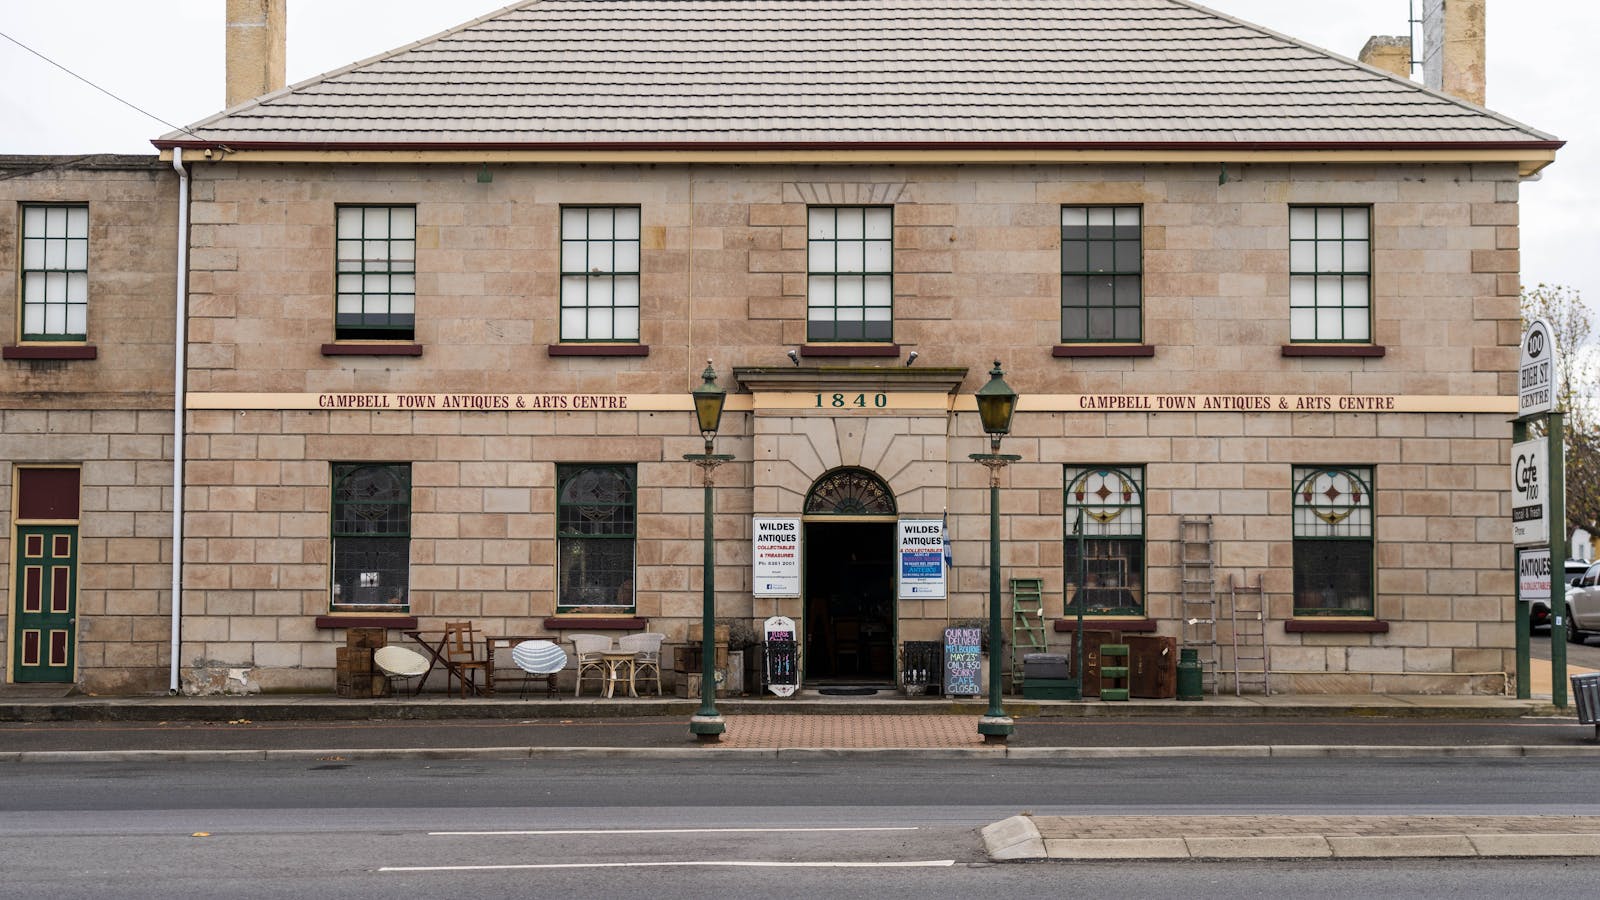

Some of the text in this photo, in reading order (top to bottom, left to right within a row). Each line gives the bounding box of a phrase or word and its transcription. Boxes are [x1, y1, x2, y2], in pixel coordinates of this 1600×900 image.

[1529, 334, 1542, 354] 100
[1521, 362, 1549, 389] HIGH ST
[318, 394, 628, 410] CAMPBELL TOWN ANTIQUES & ARTS CENTRE
[815, 393, 887, 408] 1840
[1079, 396, 1395, 411] CAMPBELL TOWN ANTIQUES & ARTS CENTRE
[1521, 388, 1549, 409] CENTRE
[759, 523, 795, 531] WILDES
[904, 525, 940, 534] WILDES
[757, 534, 797, 543] ANTIQUES
[902, 537, 942, 546] ANTIQUES
[1520, 557, 1551, 579] ANTIQUES
[945, 628, 980, 638] OUR NEXT
[948, 637, 978, 645] DELIVERY
[950, 653, 965, 661] MAY
[947, 661, 966, 670] ONLY
[951, 669, 976, 677] SORRY
[950, 676, 975, 686] CAFE
[948, 684, 980, 694] CLOSED
